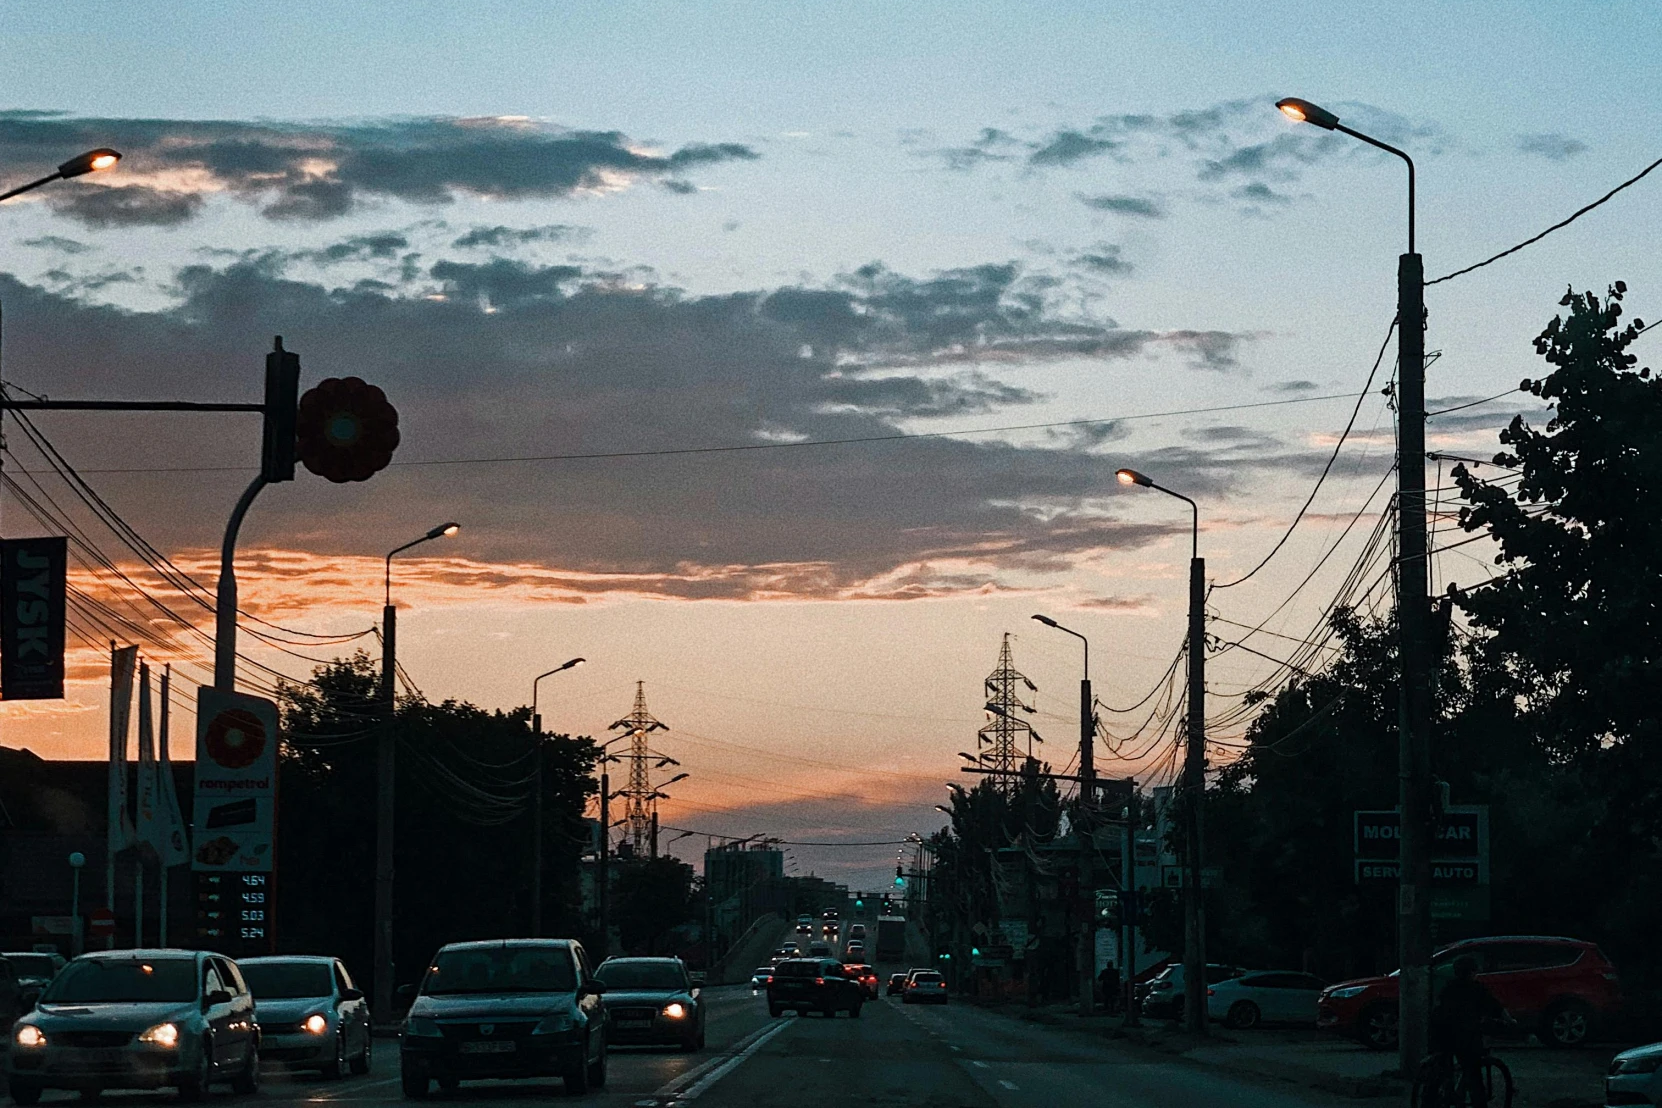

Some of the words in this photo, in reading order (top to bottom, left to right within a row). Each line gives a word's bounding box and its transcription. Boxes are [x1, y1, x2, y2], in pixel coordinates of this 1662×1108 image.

[16, 548, 50, 660] JYSK
[200, 777, 269, 792] rompetrol
[1363, 825, 1402, 840] MOL
[1363, 865, 1402, 878] SERV
[1432, 866, 1474, 879] AUTO
[241, 875, 266, 886] 4.64
[241, 893, 265, 904] 4.59
[241, 910, 265, 921] 5.03
[240, 928, 265, 939] 5.24
